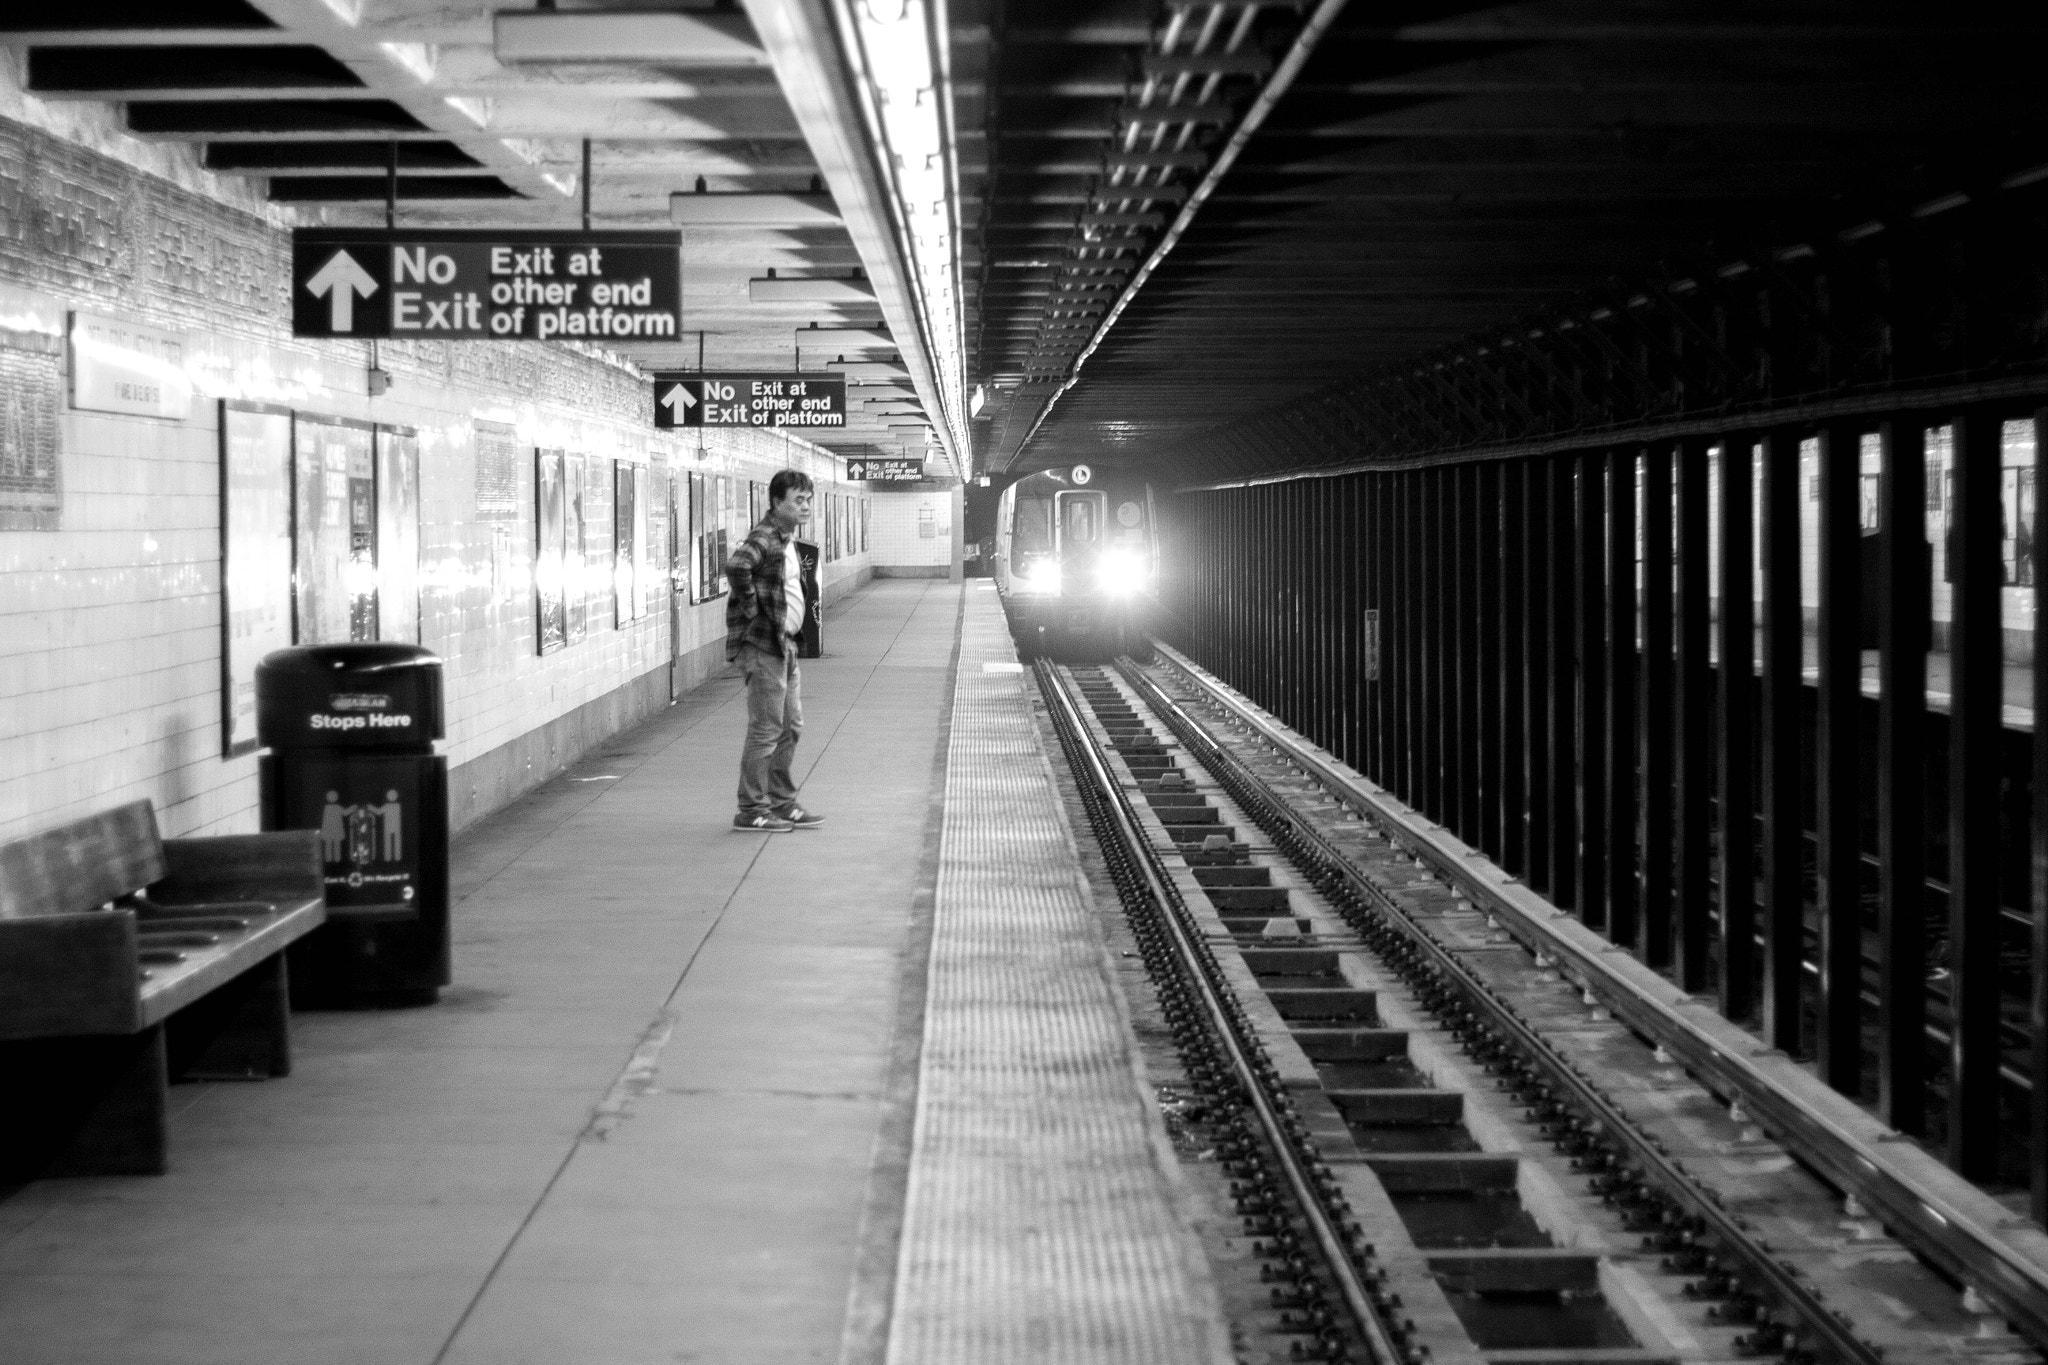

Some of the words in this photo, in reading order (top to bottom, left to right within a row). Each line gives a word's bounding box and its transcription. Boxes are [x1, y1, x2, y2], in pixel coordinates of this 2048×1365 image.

[394, 247, 456, 284] No
[491, 247, 554, 275] Exit
[568, 249, 602, 276] at
[491, 277, 577, 305] other
[591, 278, 651, 306] end
[394, 292, 481, 329] Exit
[491, 307, 525, 334] of
[538, 307, 675, 340] platform
[704, 382, 735, 401] No
[752, 382, 783, 396] Exit
[789, 382, 807, 396] at
[752, 396, 795, 411] other
[801, 396, 831, 411] end
[704, 404, 748, 423] Exit
[752, 411, 769, 425] of
[775, 411, 843, 428] platform
[866, 461, 880, 471] No
[866, 470, 885, 479] Exit
[310, 714, 366, 731] Stops
[369, 712, 411, 727] Here
